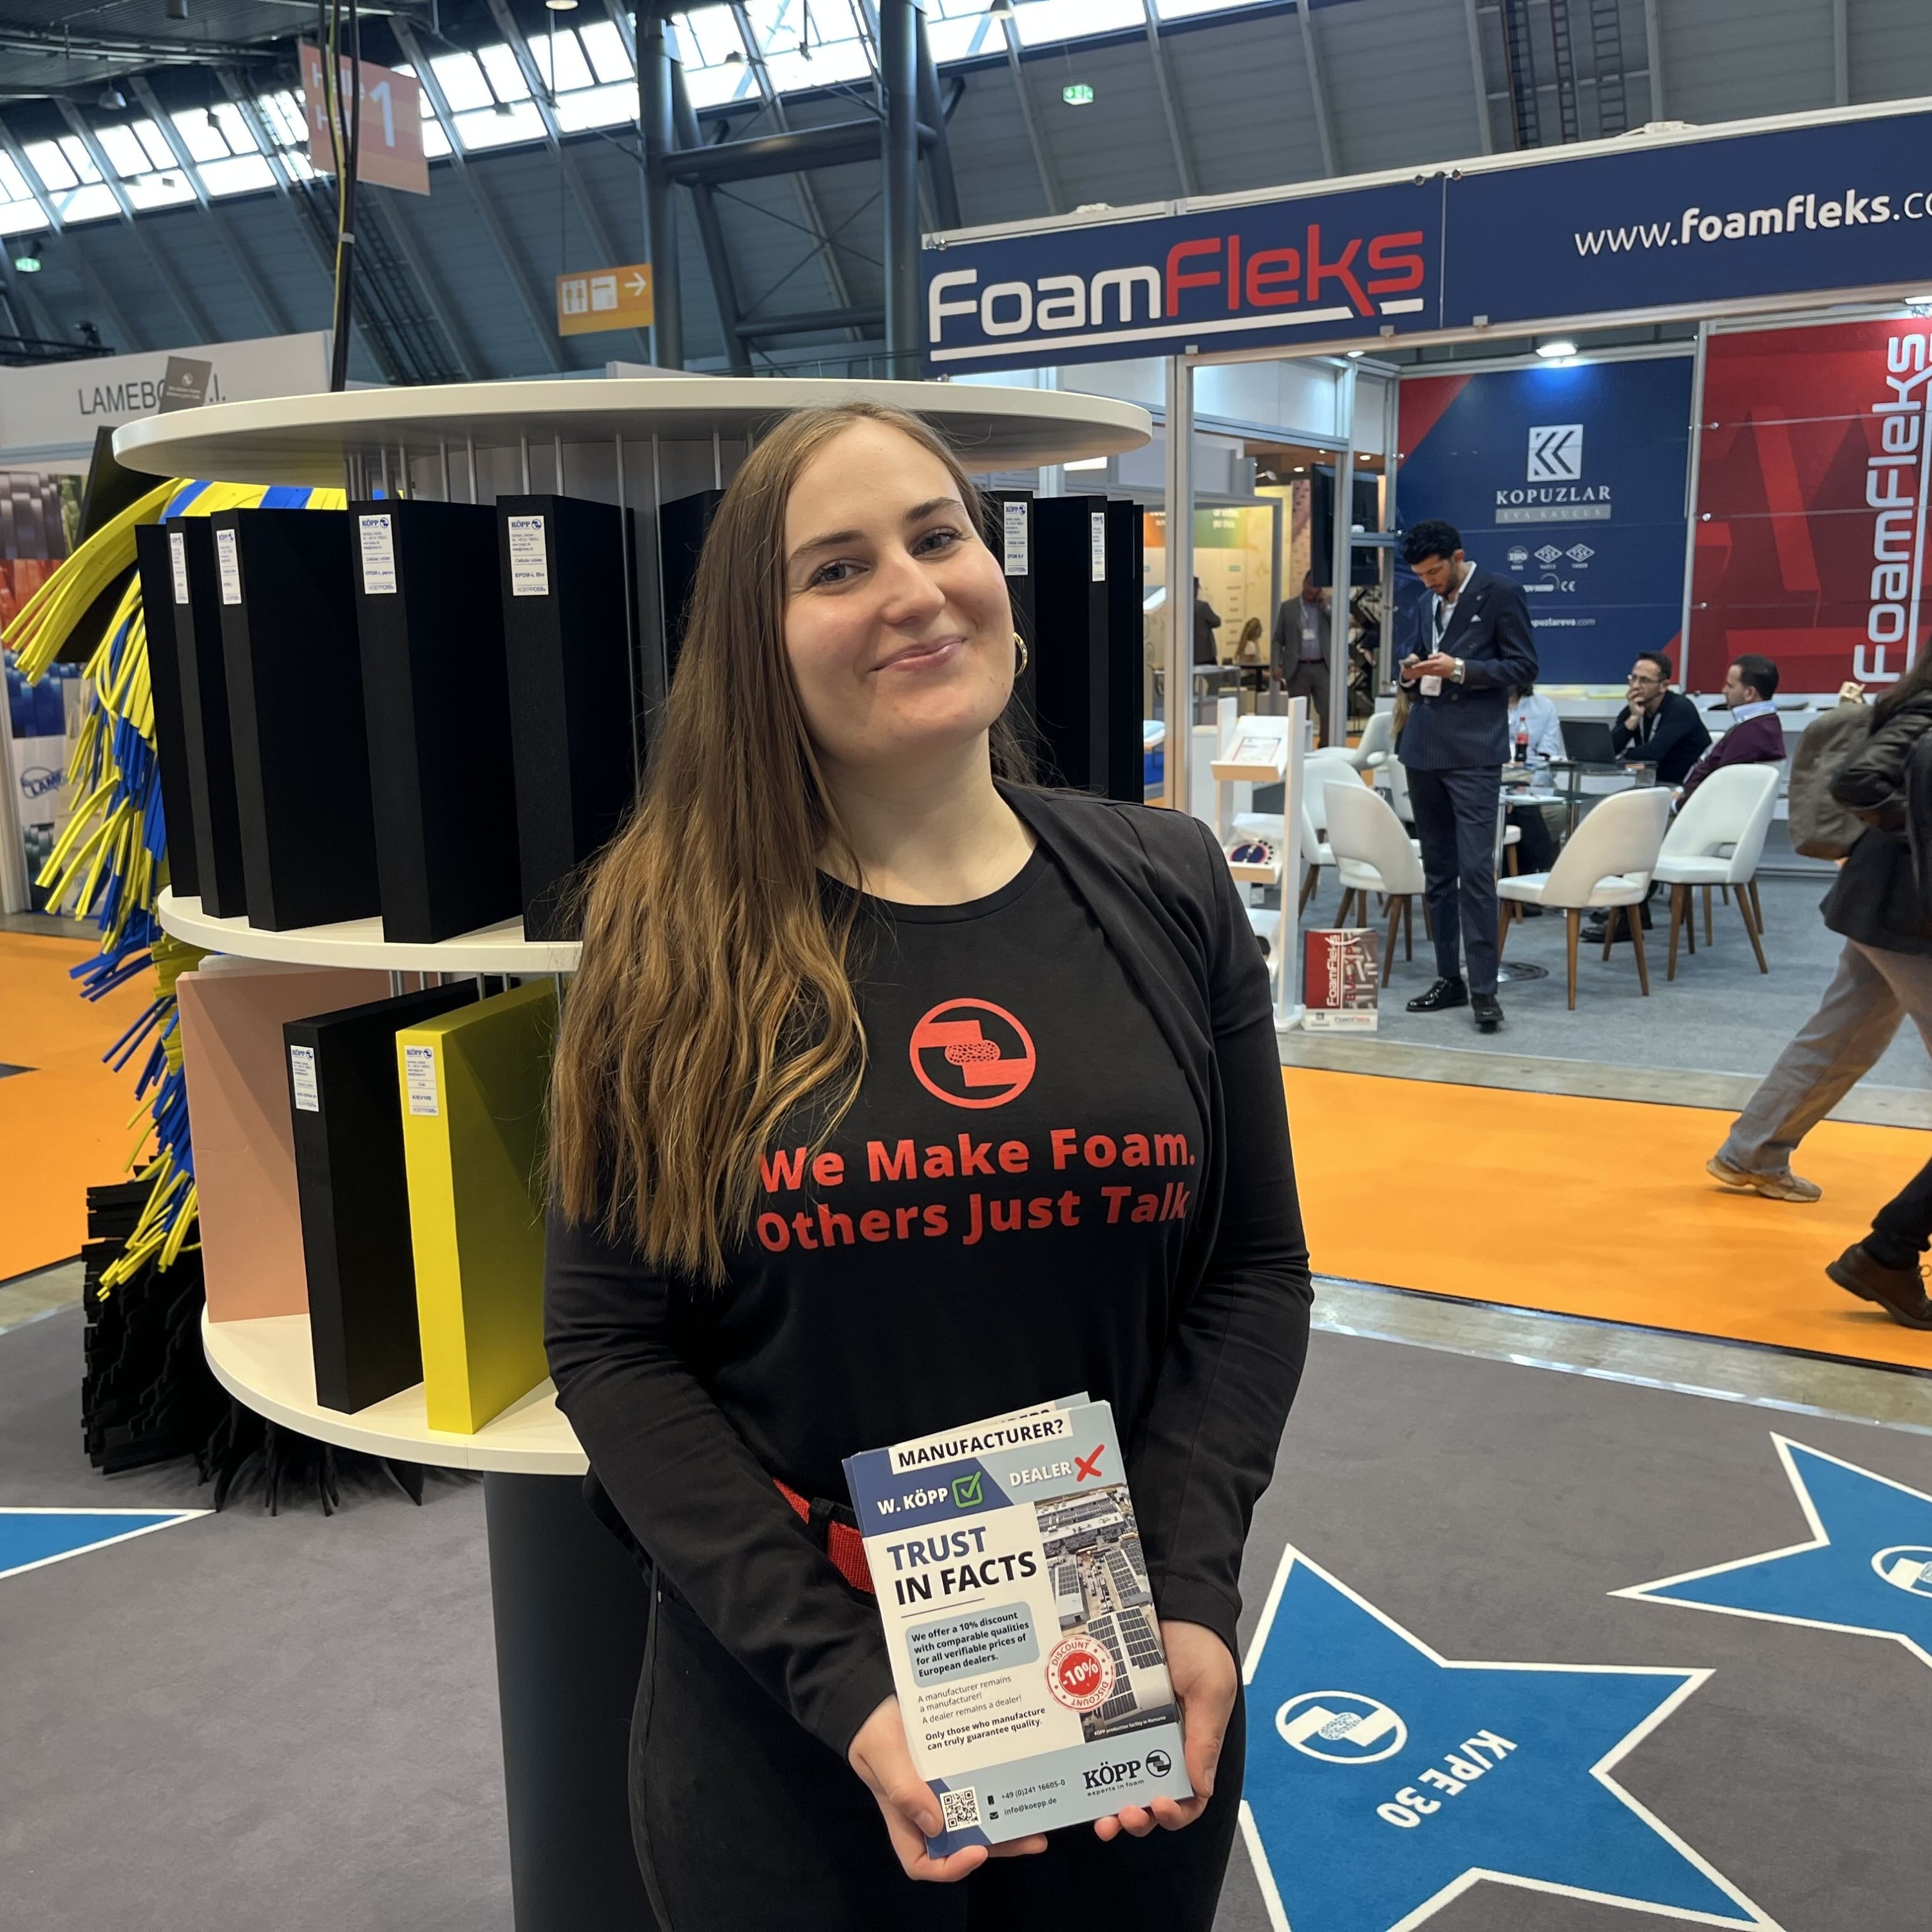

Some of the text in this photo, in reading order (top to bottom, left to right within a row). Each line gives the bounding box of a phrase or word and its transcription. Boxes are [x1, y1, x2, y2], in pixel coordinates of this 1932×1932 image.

[370, 80, 395, 147] 1
[1496, 486, 1611, 505] KOPUZLAR
[759, 1128, 1196, 1193] We Make Foam.
[756, 1182, 1191, 1253] Others Just Talk
[898, 1419, 1065, 1467] MANUFACTURER?
[1009, 1461, 1072, 1486] DEALER
[877, 1487, 949, 1515] W. KÖPP
[887, 1526, 986, 1571] TRUST
[895, 1551, 1037, 1605] IN FACTS
[911, 1633, 926, 1643] We
[928, 1626, 950, 1638] offer
[959, 1621, 979, 1631] 10%
[980, 1612, 1018, 1627] discount
[914, 1622, 1030, 1654] with comparable qualities
[916, 1633, 1027, 1666] for all verifiable prices of
[1052, 1642, 1089, 1666] DISCOUNT
[918, 1652, 998, 1678] European dealers.
[1063, 1658, 1099, 1687] -10%
[925, 1682, 978, 1701] manufacturer
[980, 1675, 1012, 1689] remains
[926, 1692, 983, 1712] manufacturer!
[1071, 1681, 1109, 1707] DISCOUNT
[929, 1710, 953, 1723] dealer
[956, 1703, 987, 1716] remains
[995, 1694, 1022, 1707] dealer!
[925, 1707, 1046, 1741] Only those who manufacture
[927, 1717, 1043, 1750] can truly guarantee quality.
[1083, 1760, 1141, 1789] KÖPP
[1087, 1785, 1116, 1797] experts
[1126, 1779, 1144, 1788] foam
[1376, 1729, 1518, 1828] K/PE 30
[1001, 1779, 1066, 1800] +49 (0)241 16605-0
[1004, 1797, 1057, 1815] info@koepp.de
